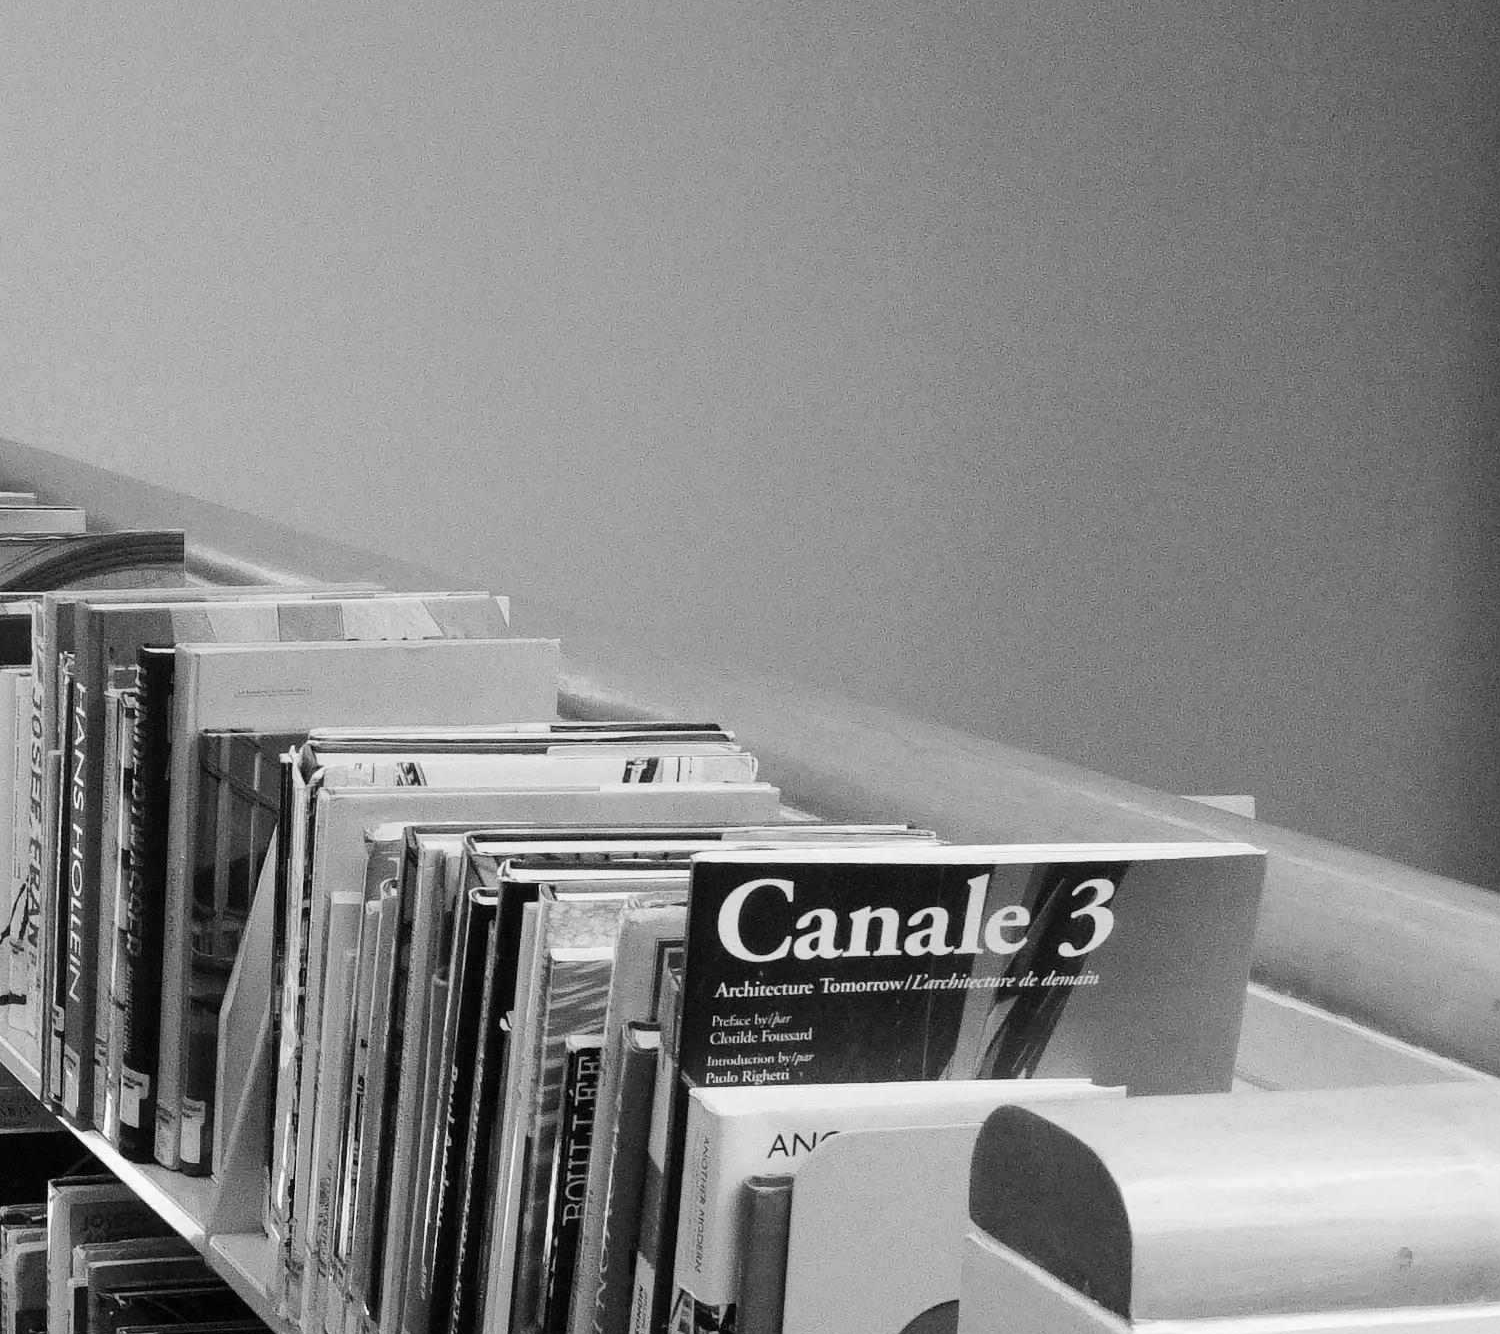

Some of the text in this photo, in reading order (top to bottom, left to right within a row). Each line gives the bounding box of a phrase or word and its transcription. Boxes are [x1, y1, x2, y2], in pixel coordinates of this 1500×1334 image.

[26, 685, 44, 967] JOSEF FRAN
[69, 679, 86, 1005] HANS HOLLEIN
[717, 873, 1116, 963] Canale 3
[713, 977, 815, 999] Architecture
[1017, 971, 1038, 988] de
[1041, 969, 1100, 987] demain
[711, 1013, 752, 1027] Preface
[709, 1027, 813, 1045] Clotilde Foussard
[706, 1053, 775, 1068] Introduction
[705, 1067, 790, 1086] Paolo Righetti
[766, 1131, 840, 1159] AN
[694, 1135, 710, 1274] ANOTHER MODERN
